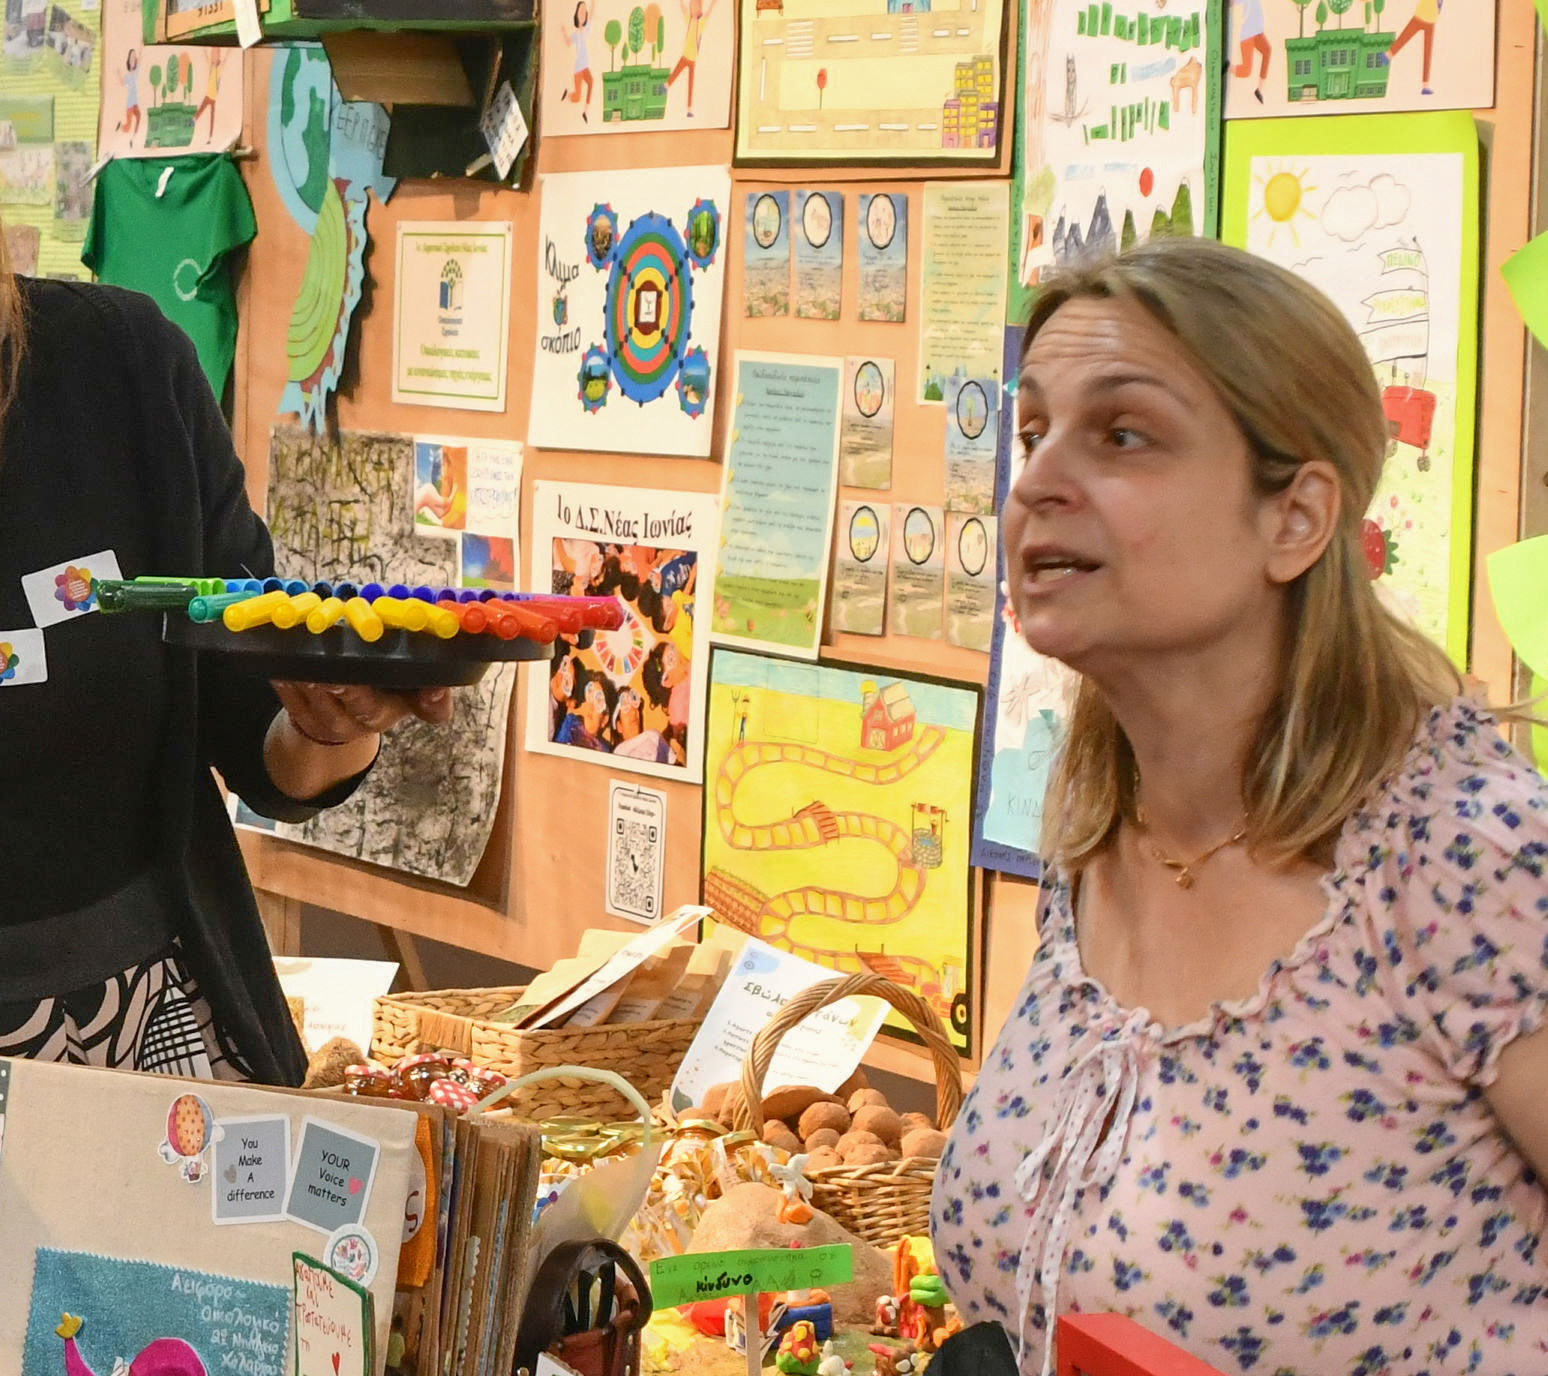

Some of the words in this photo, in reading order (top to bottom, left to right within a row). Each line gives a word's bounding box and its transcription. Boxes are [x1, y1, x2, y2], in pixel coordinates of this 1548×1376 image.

[643, 511, 692, 540] Ιωνίας
[241, 1138, 258, 1150] You
[238, 1155, 263, 1166] Make
[321, 1150, 350, 1171] YOUR
[248, 1172, 254, 1183] A
[319, 1169, 344, 1187] Voice
[227, 1189, 275, 1201] difference
[308, 1184, 347, 1206] matters
